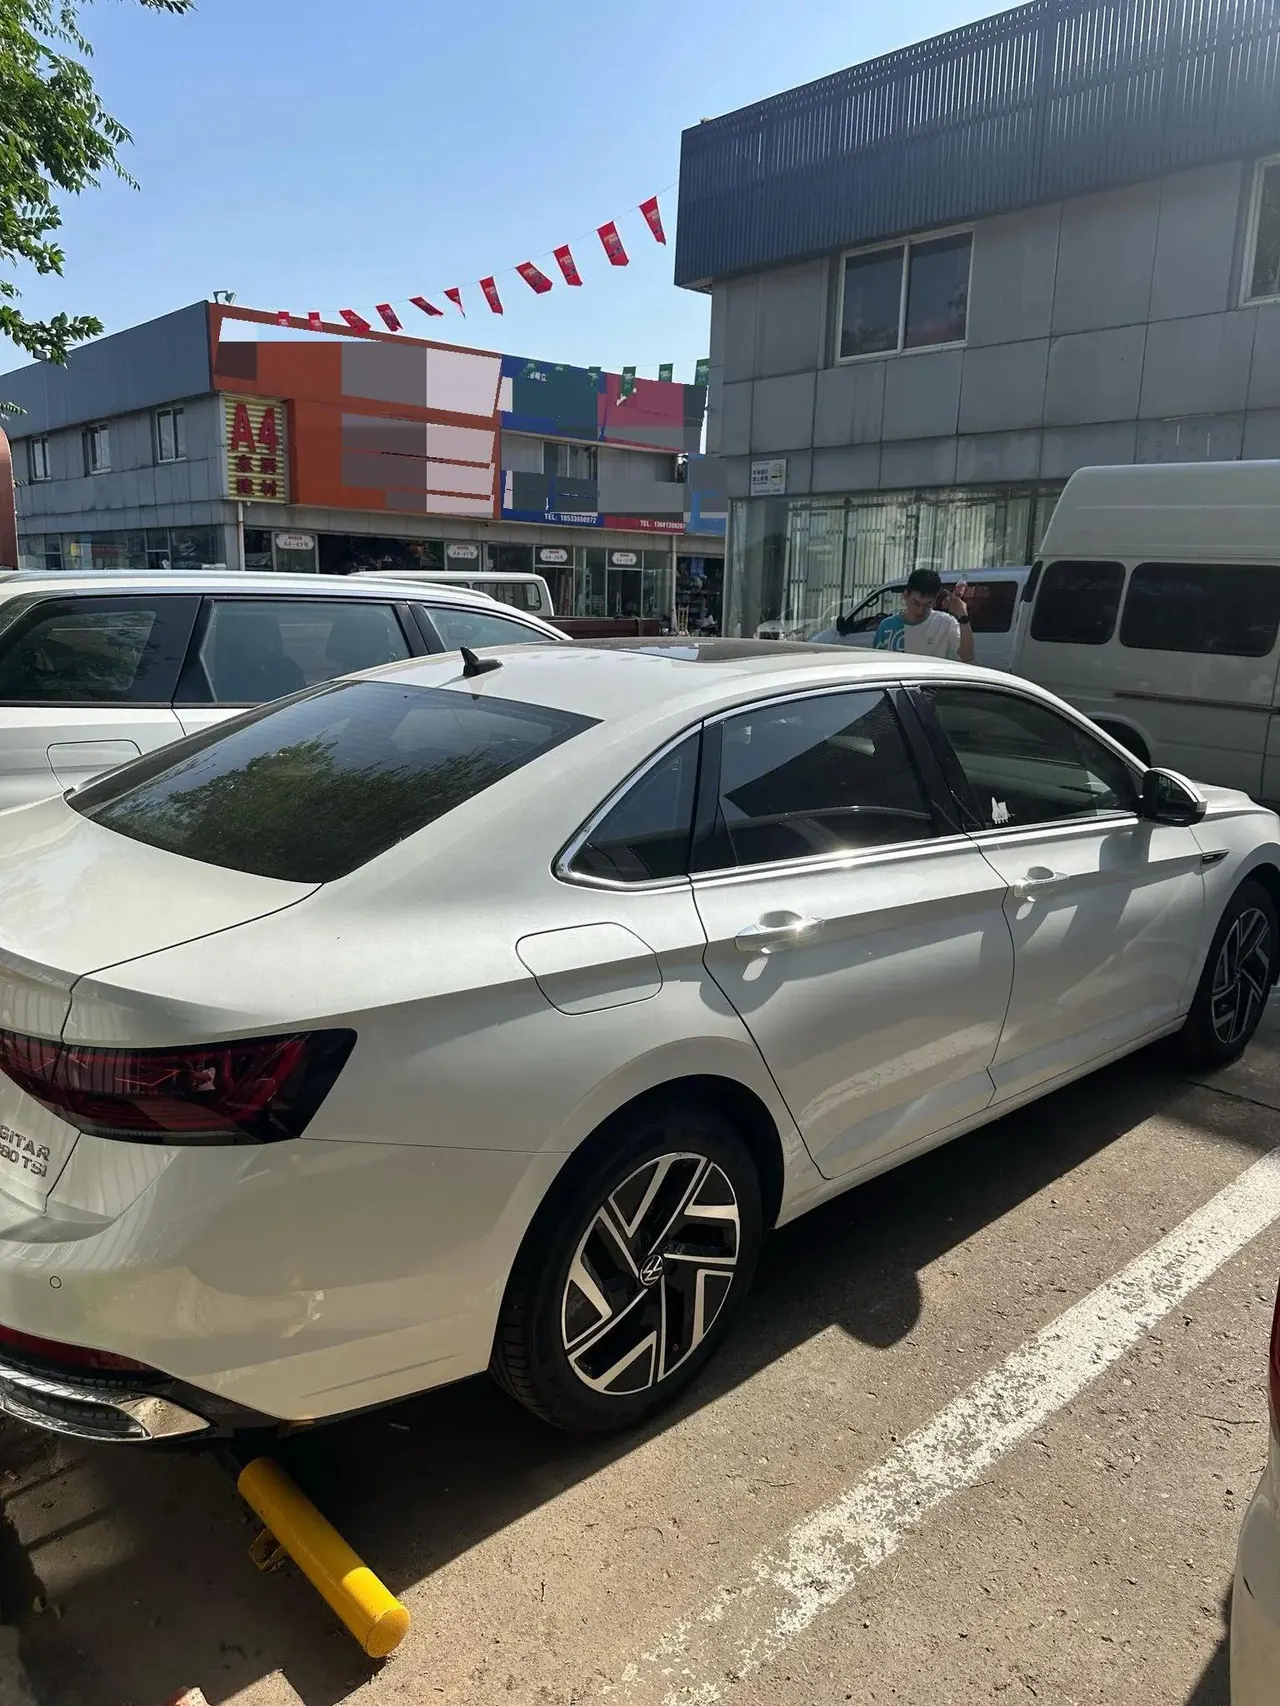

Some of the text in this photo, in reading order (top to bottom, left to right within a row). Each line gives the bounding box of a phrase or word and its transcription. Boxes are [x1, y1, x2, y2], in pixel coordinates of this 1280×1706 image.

[230, 403, 278, 454] A4
[236, 477, 277, 497] 建材
[0, 1142, 48, 1178] 80 TSI
